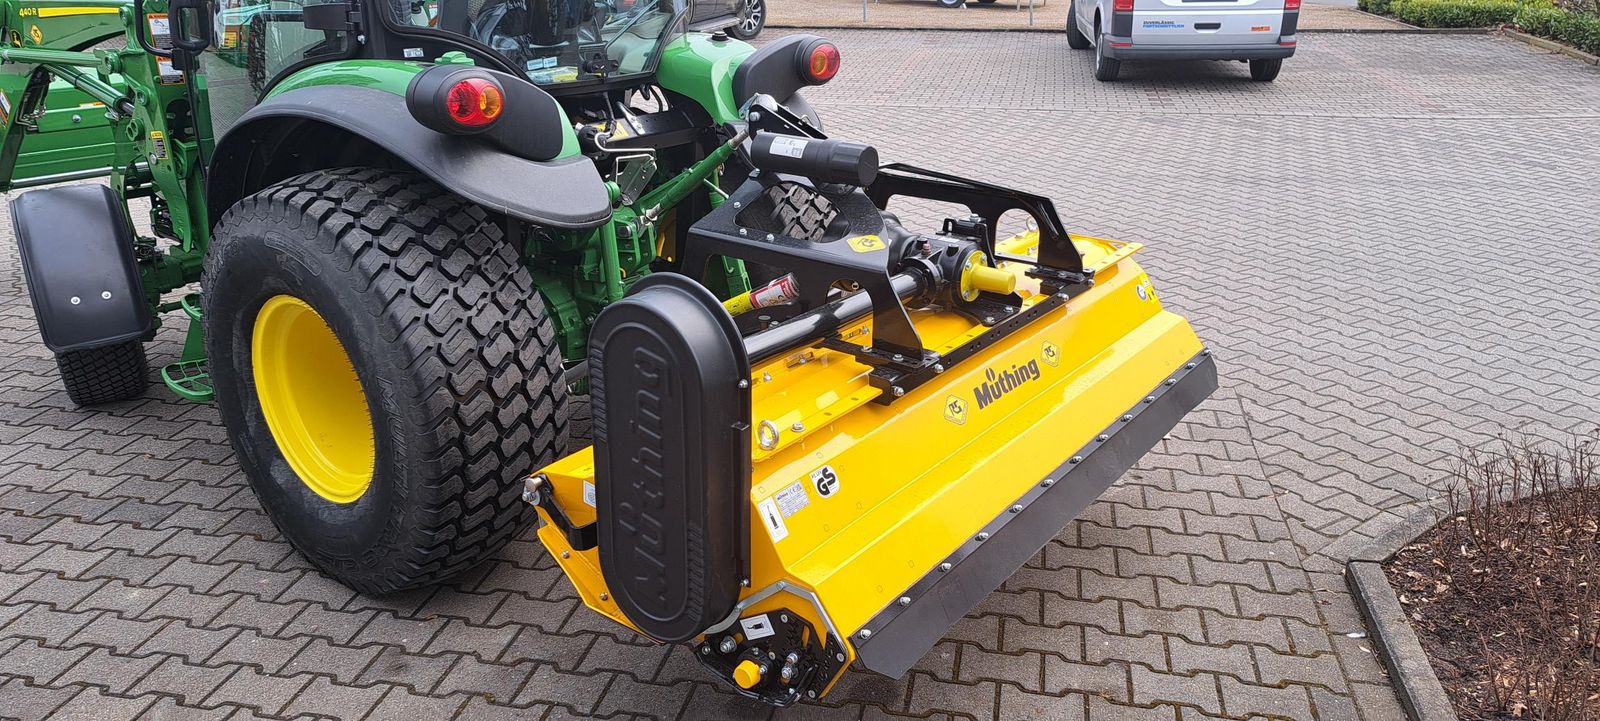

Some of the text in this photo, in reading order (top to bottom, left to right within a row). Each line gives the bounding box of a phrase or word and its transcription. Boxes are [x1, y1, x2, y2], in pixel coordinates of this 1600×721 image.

[972, 358, 1041, 410] Müthing
[618, 346, 672, 609] Müthing
[816, 467, 837, 496] GS
